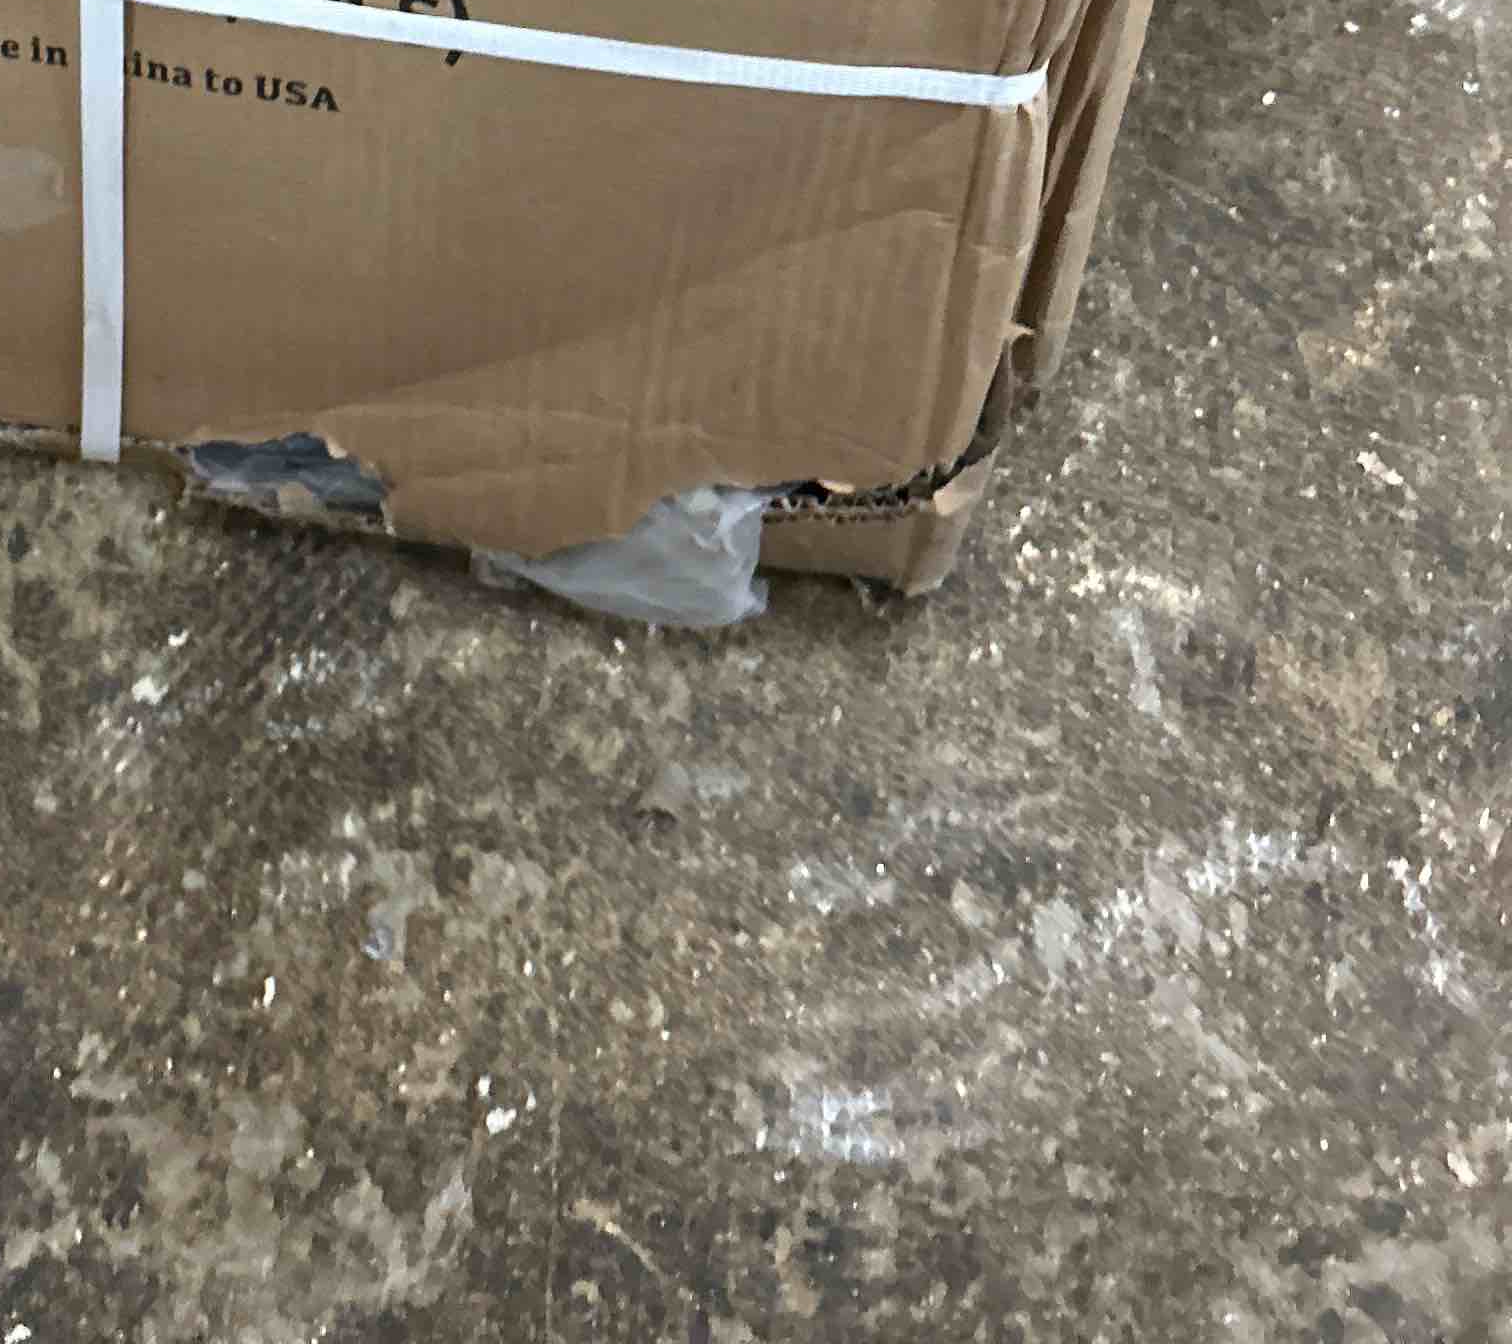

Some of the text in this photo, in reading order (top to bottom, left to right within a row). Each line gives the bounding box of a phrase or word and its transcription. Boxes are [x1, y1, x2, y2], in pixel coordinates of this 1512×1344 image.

[31, 35, 68, 67] in
[124, 49, 191, 89] ina
[204, 68, 243, 97] to
[255, 76, 341, 112] USA
